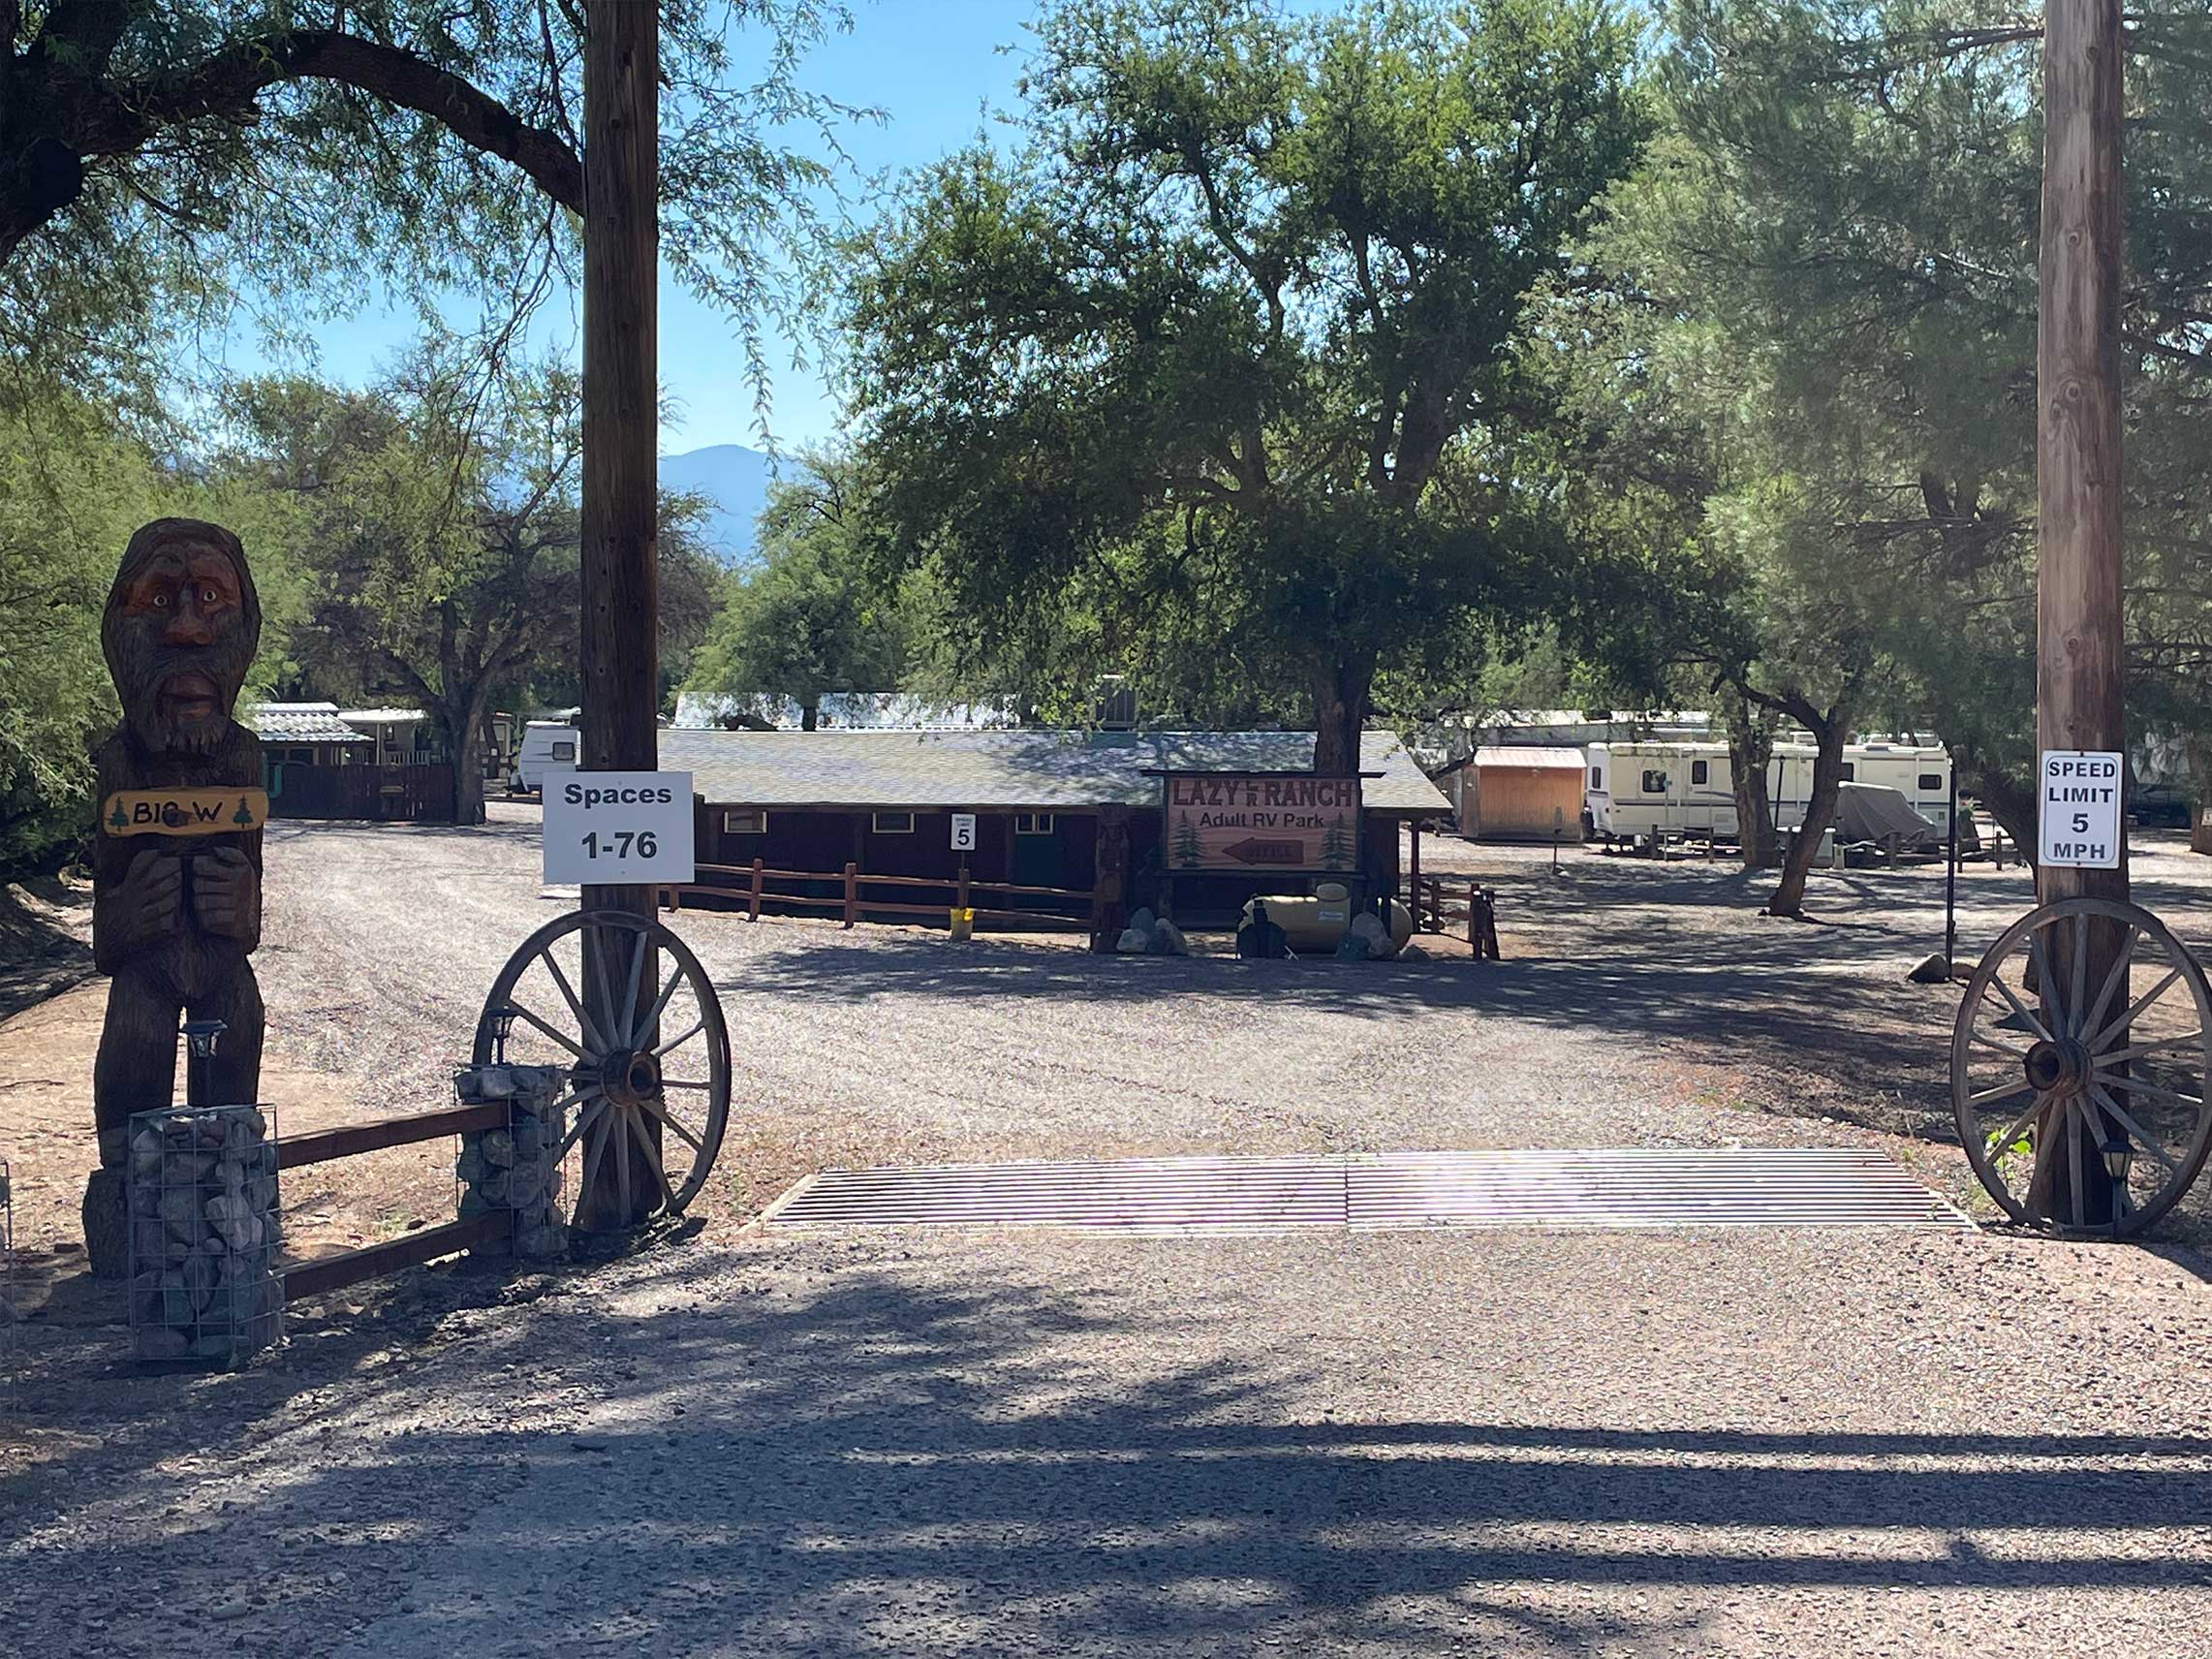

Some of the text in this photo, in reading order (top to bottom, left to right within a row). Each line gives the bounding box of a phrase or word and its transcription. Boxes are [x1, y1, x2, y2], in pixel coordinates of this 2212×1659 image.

[2048, 762, 2115, 777] SPEED
[564, 783, 671, 809] Spaces
[1173, 779, 1238, 806] LAZY
[1263, 779, 1353, 807] RANCH
[2048, 787, 2113, 802] LIMIT
[192, 801, 223, 822] W
[1199, 811, 1324, 829] Adult RV Park
[2072, 813, 2089, 833] 5
[581, 830, 658, 860] 1-76
[956, 829, 970, 846] 5
[2053, 843, 2105, 860] MPH
